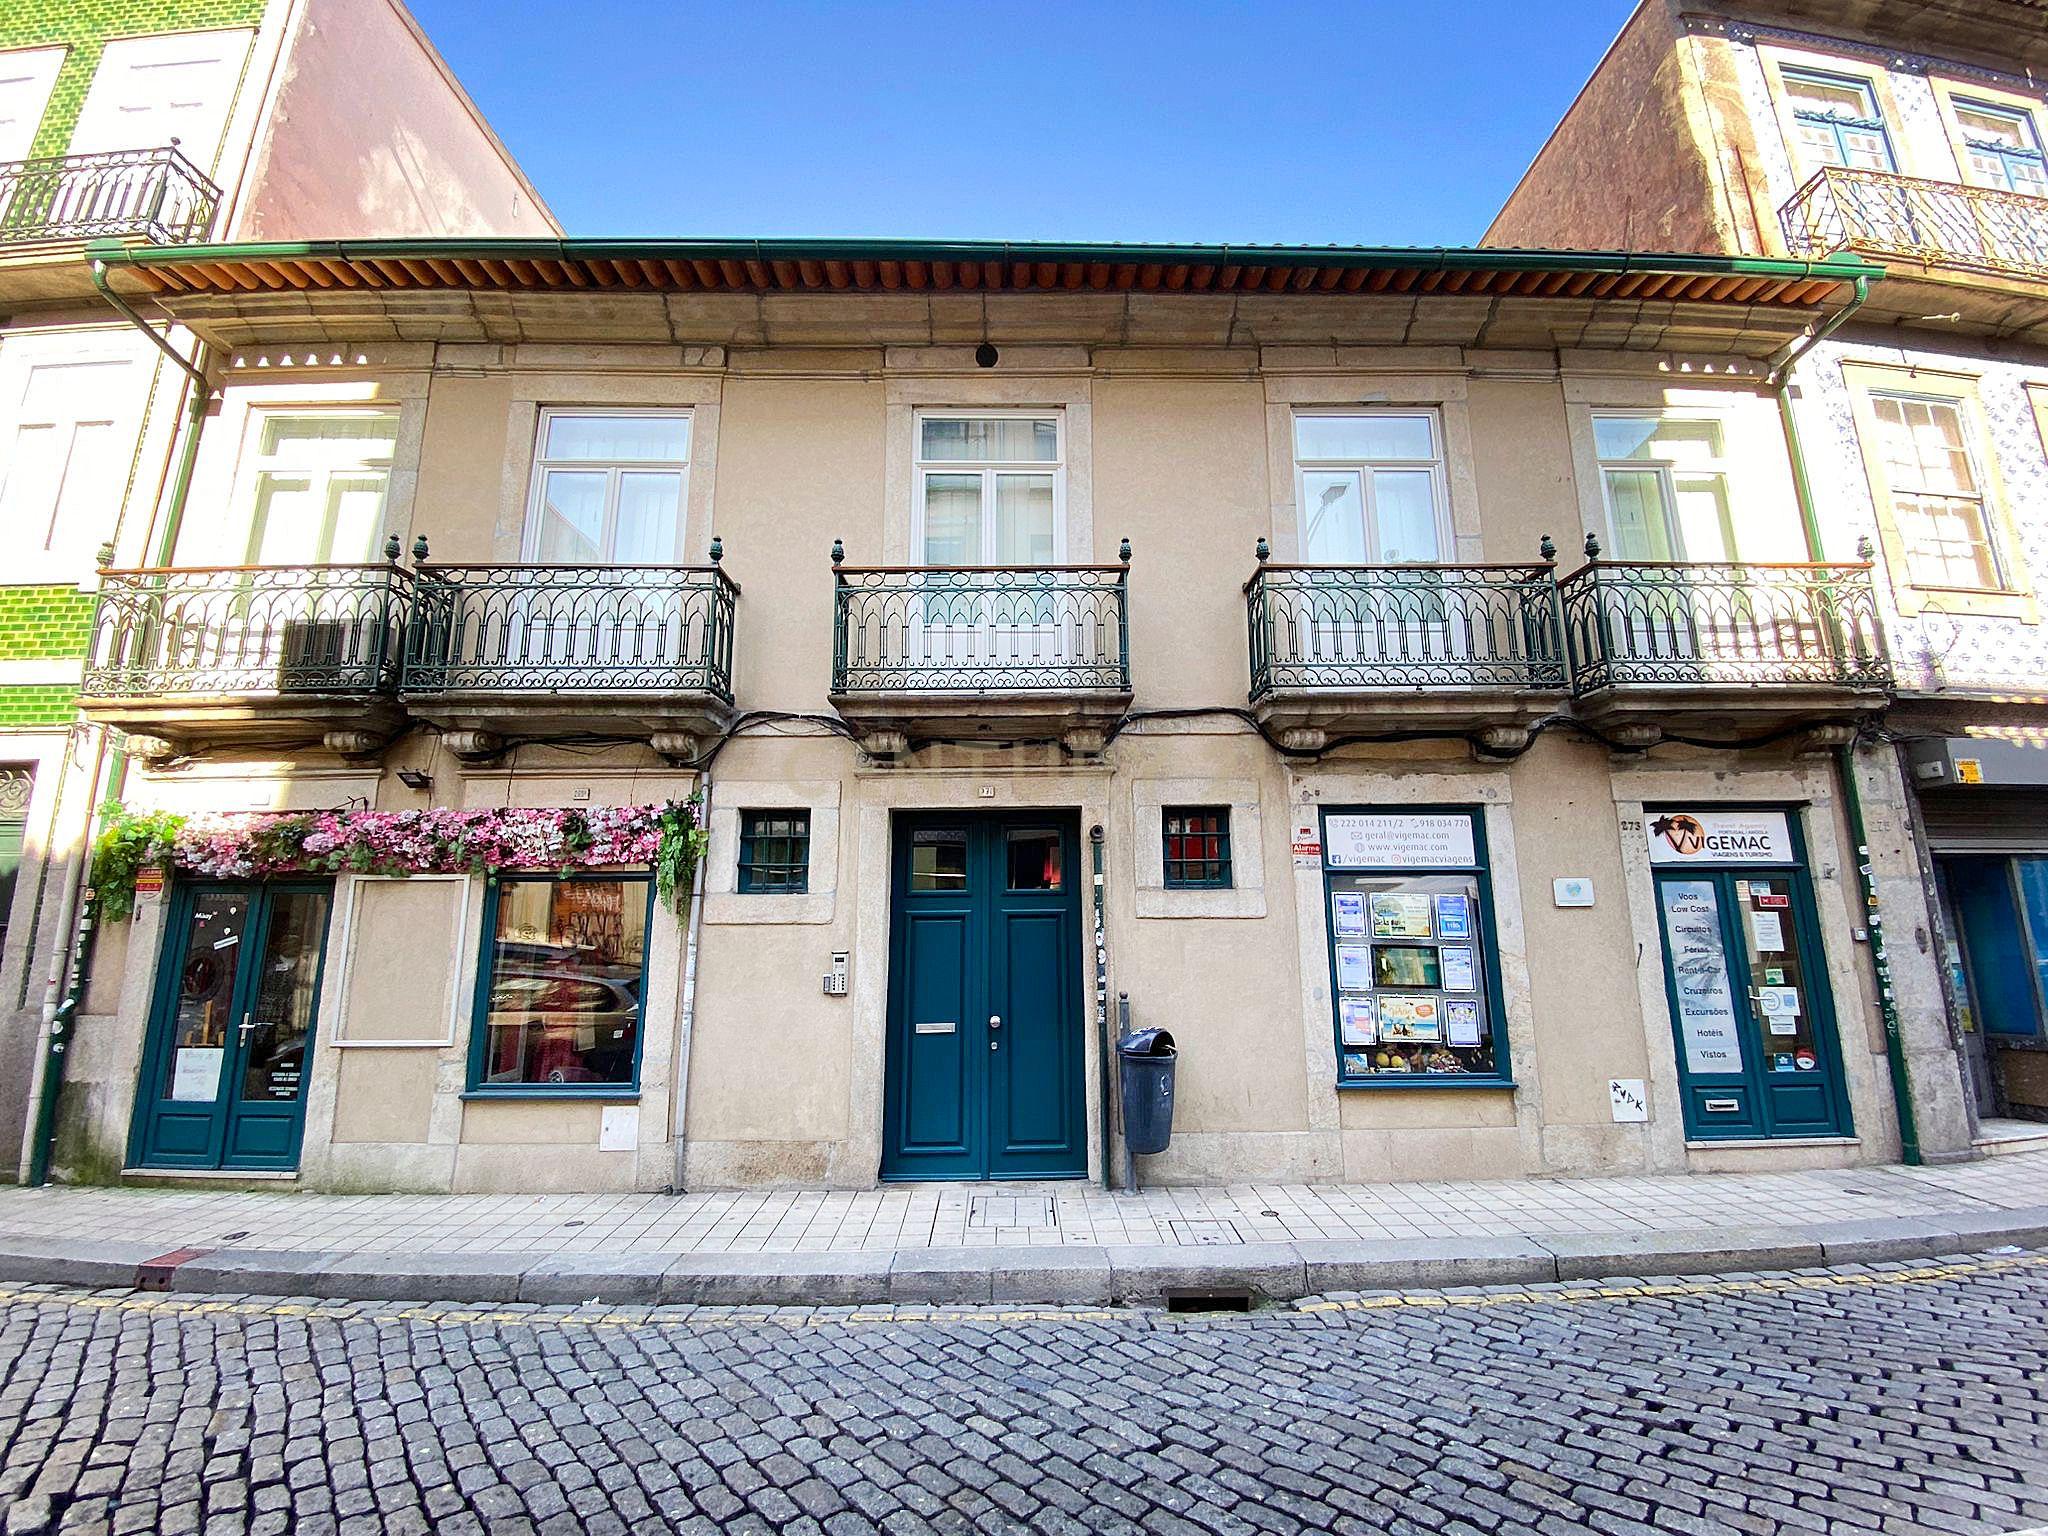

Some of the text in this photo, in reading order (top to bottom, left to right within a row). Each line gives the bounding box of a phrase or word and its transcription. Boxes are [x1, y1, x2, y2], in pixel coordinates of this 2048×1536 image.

[1341, 819, 1356, 827] 222
[1358, 819, 1374, 827] 014
[1377, 819, 1404, 828] 211/2
[1420, 819, 1435, 827] 918
[1454, 819, 1469, 827] 770
[1621, 820, 1641, 831] 273
[1365, 831, 1450, 841] geral@vigemac.com
[1368, 843, 1448, 853] www.vigemac.com
[1402, 854, 1473, 864] vigemacviagens
[1678, 892, 1698, 900] Voos
[1671, 905, 1710, 913] Low Cost
[1675, 925, 1712, 933] Circuitos
[1683, 987, 1723, 995] Cruzeiros
[1685, 1008, 1729, 1016] Excursões
[1700, 1050, 1727, 1058] Vistos
